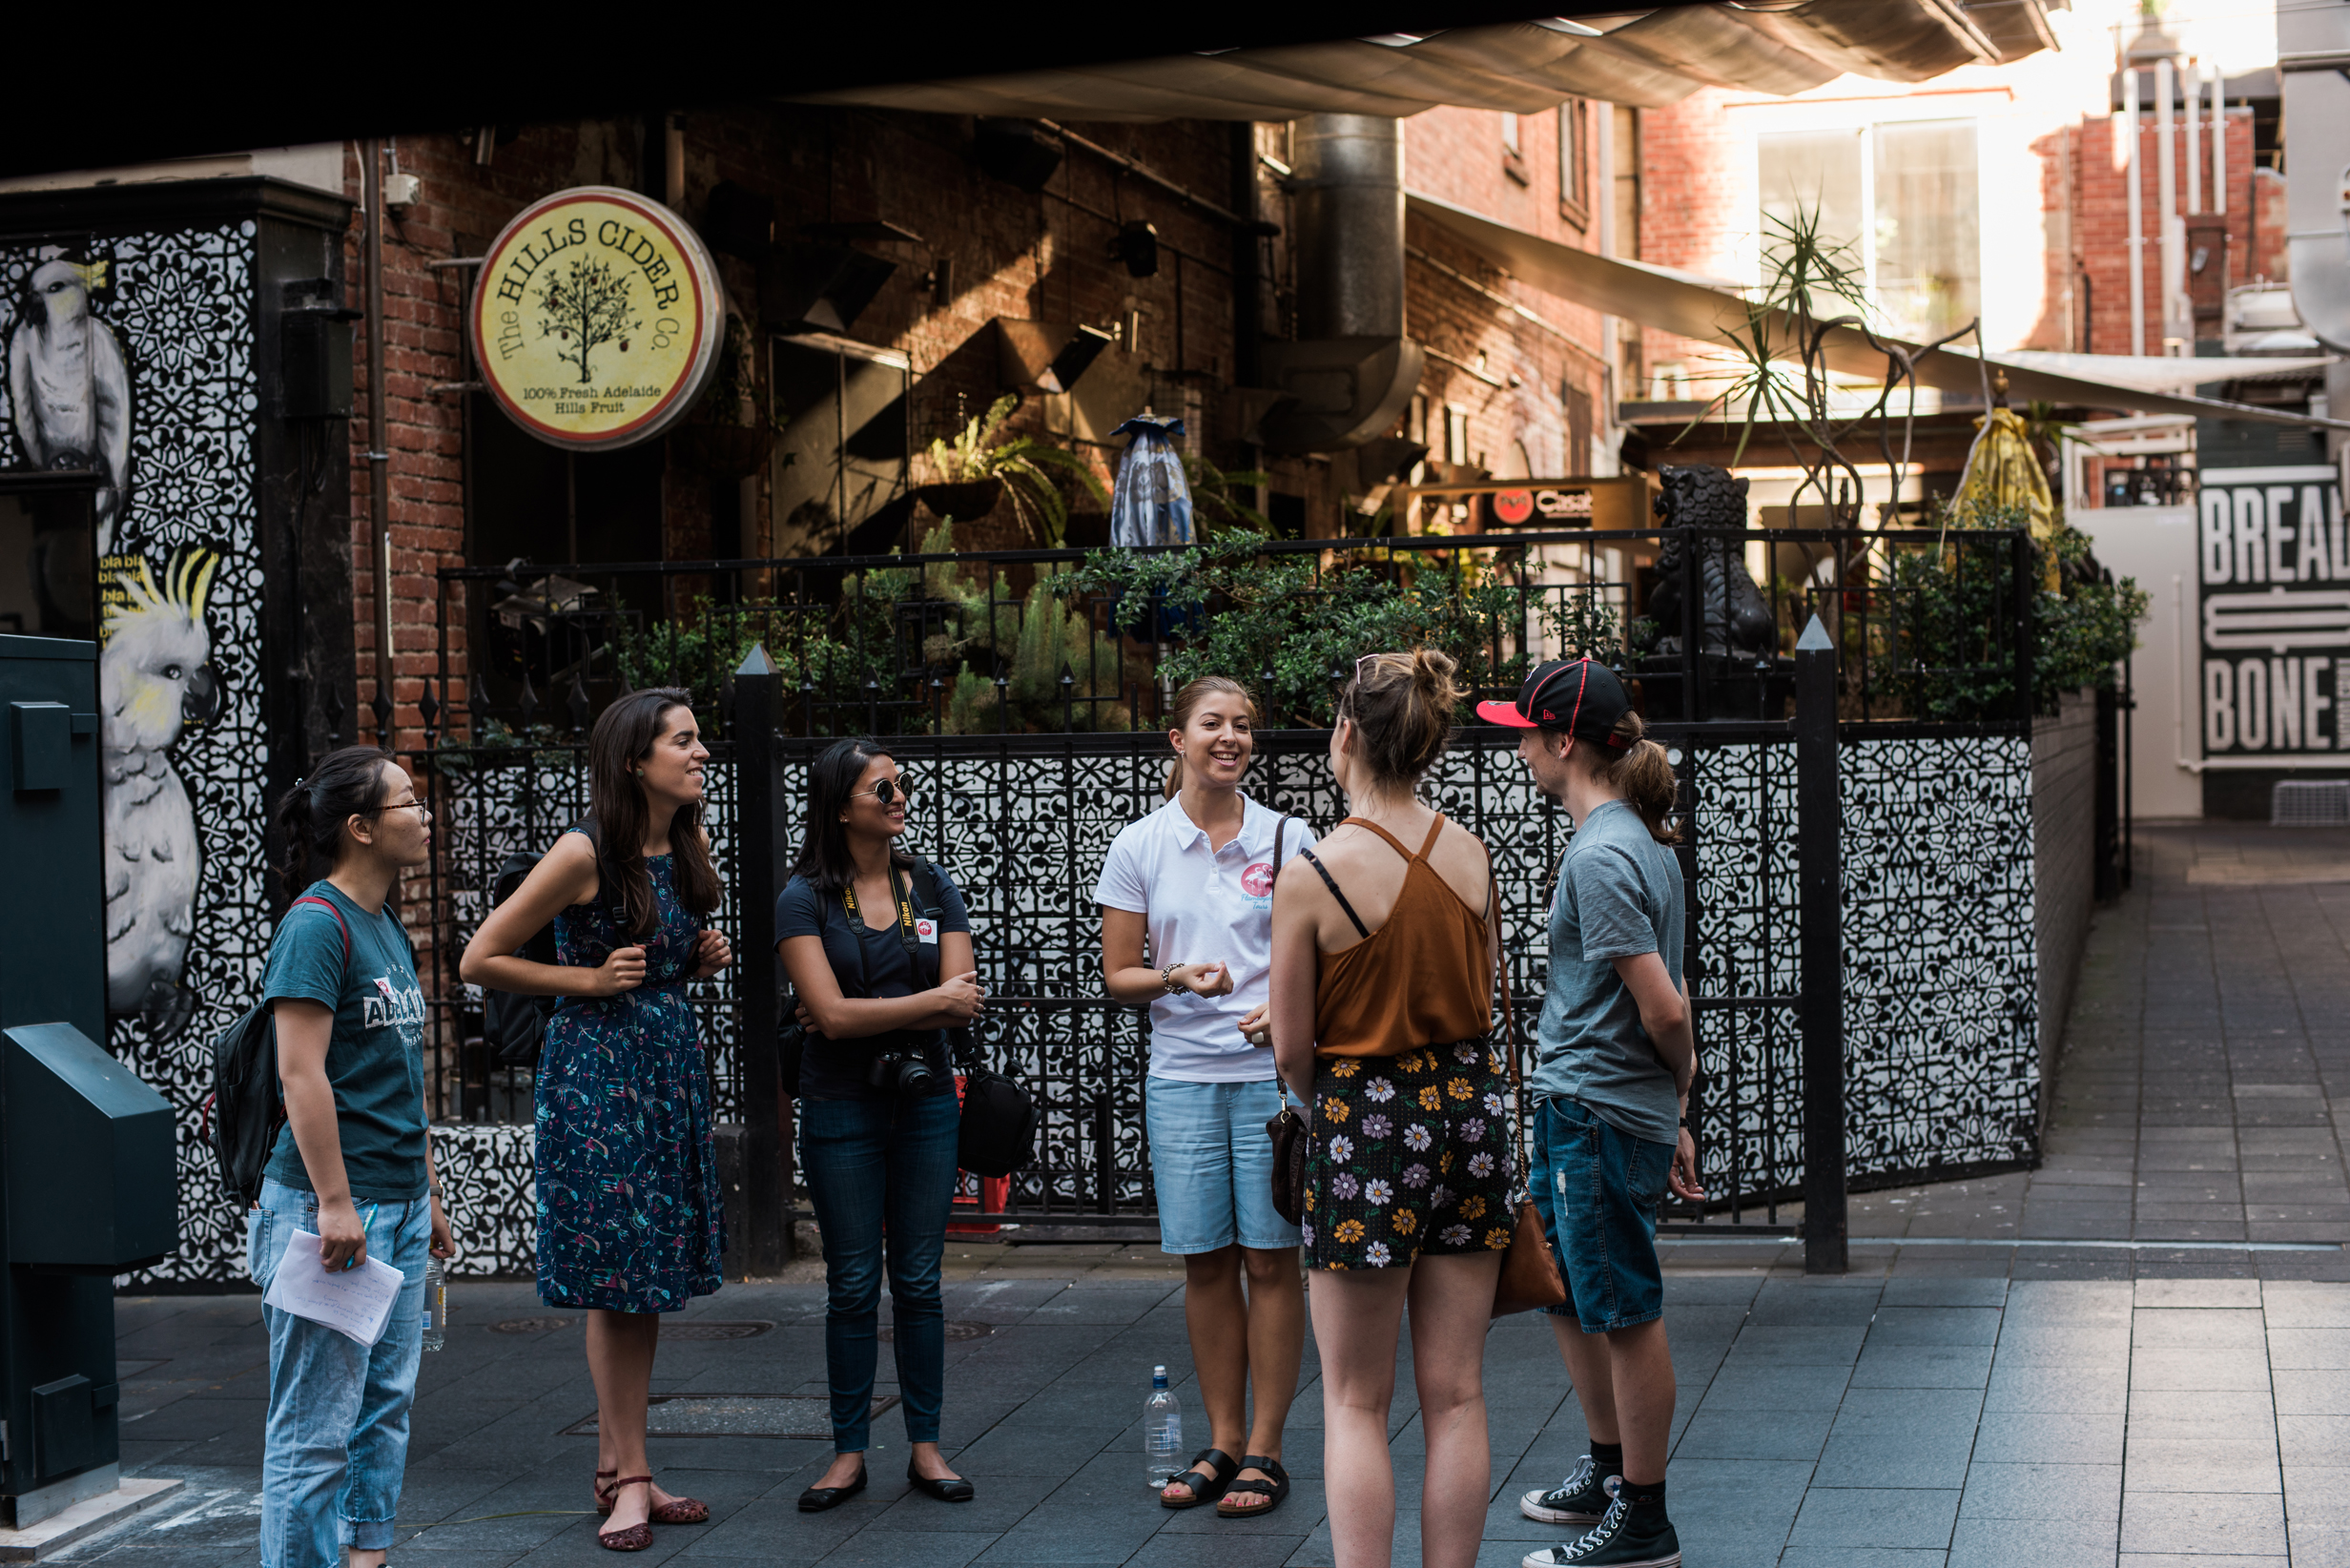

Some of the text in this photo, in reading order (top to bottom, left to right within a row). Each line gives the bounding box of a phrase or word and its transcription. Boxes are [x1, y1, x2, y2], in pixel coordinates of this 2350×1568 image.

[497, 217, 680, 361] The HILLS CIDER Co.
[523, 384, 662, 401] 100% Fresh Adelaide
[555, 401, 626, 415] Hills Fruit
[99, 554, 123, 569] bla
[102, 588, 125, 603] bla
[2204, 656, 2332, 750] BONE
[845, 887, 856, 909] Niko
[1241, 894, 1273, 902] Flamboyan
[901, 901, 913, 927] Nikon
